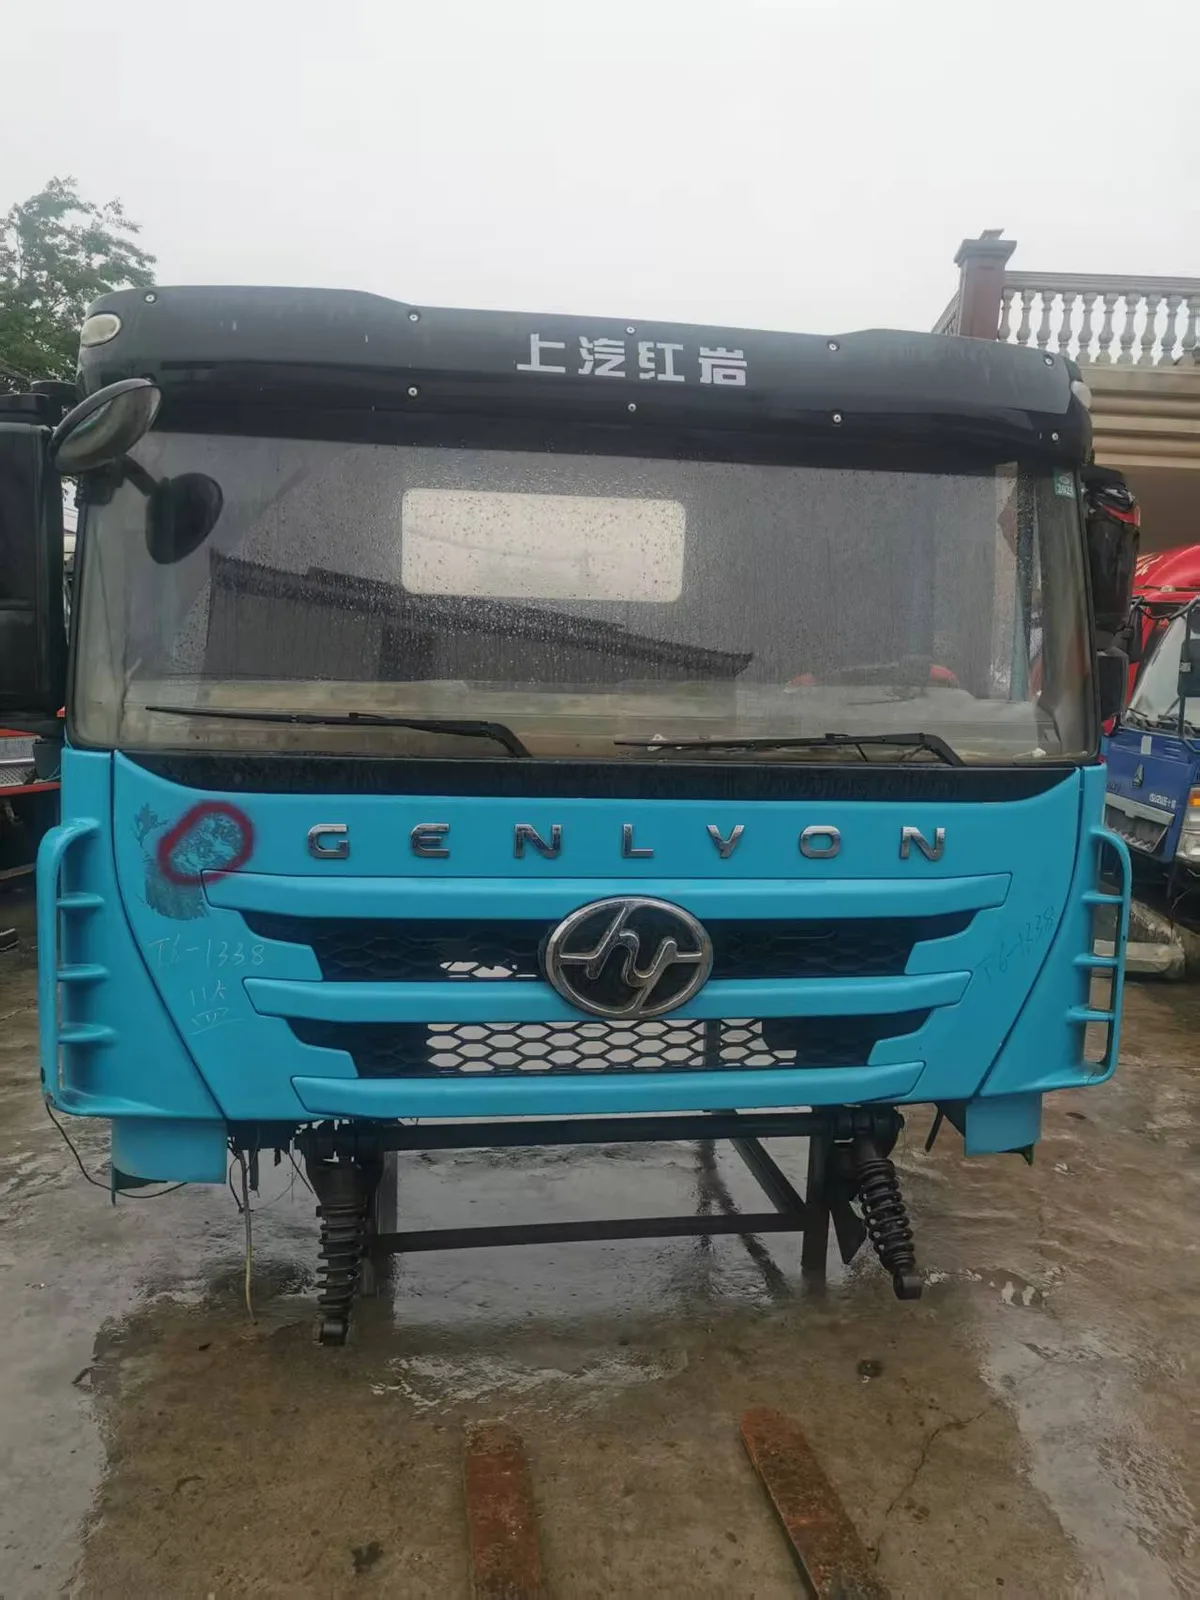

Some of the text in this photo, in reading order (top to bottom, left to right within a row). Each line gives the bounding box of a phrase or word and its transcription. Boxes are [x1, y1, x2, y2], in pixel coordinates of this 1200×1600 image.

[516, 332, 748, 387] 上汽红岩
[307, 822, 947, 861] GENLYON
